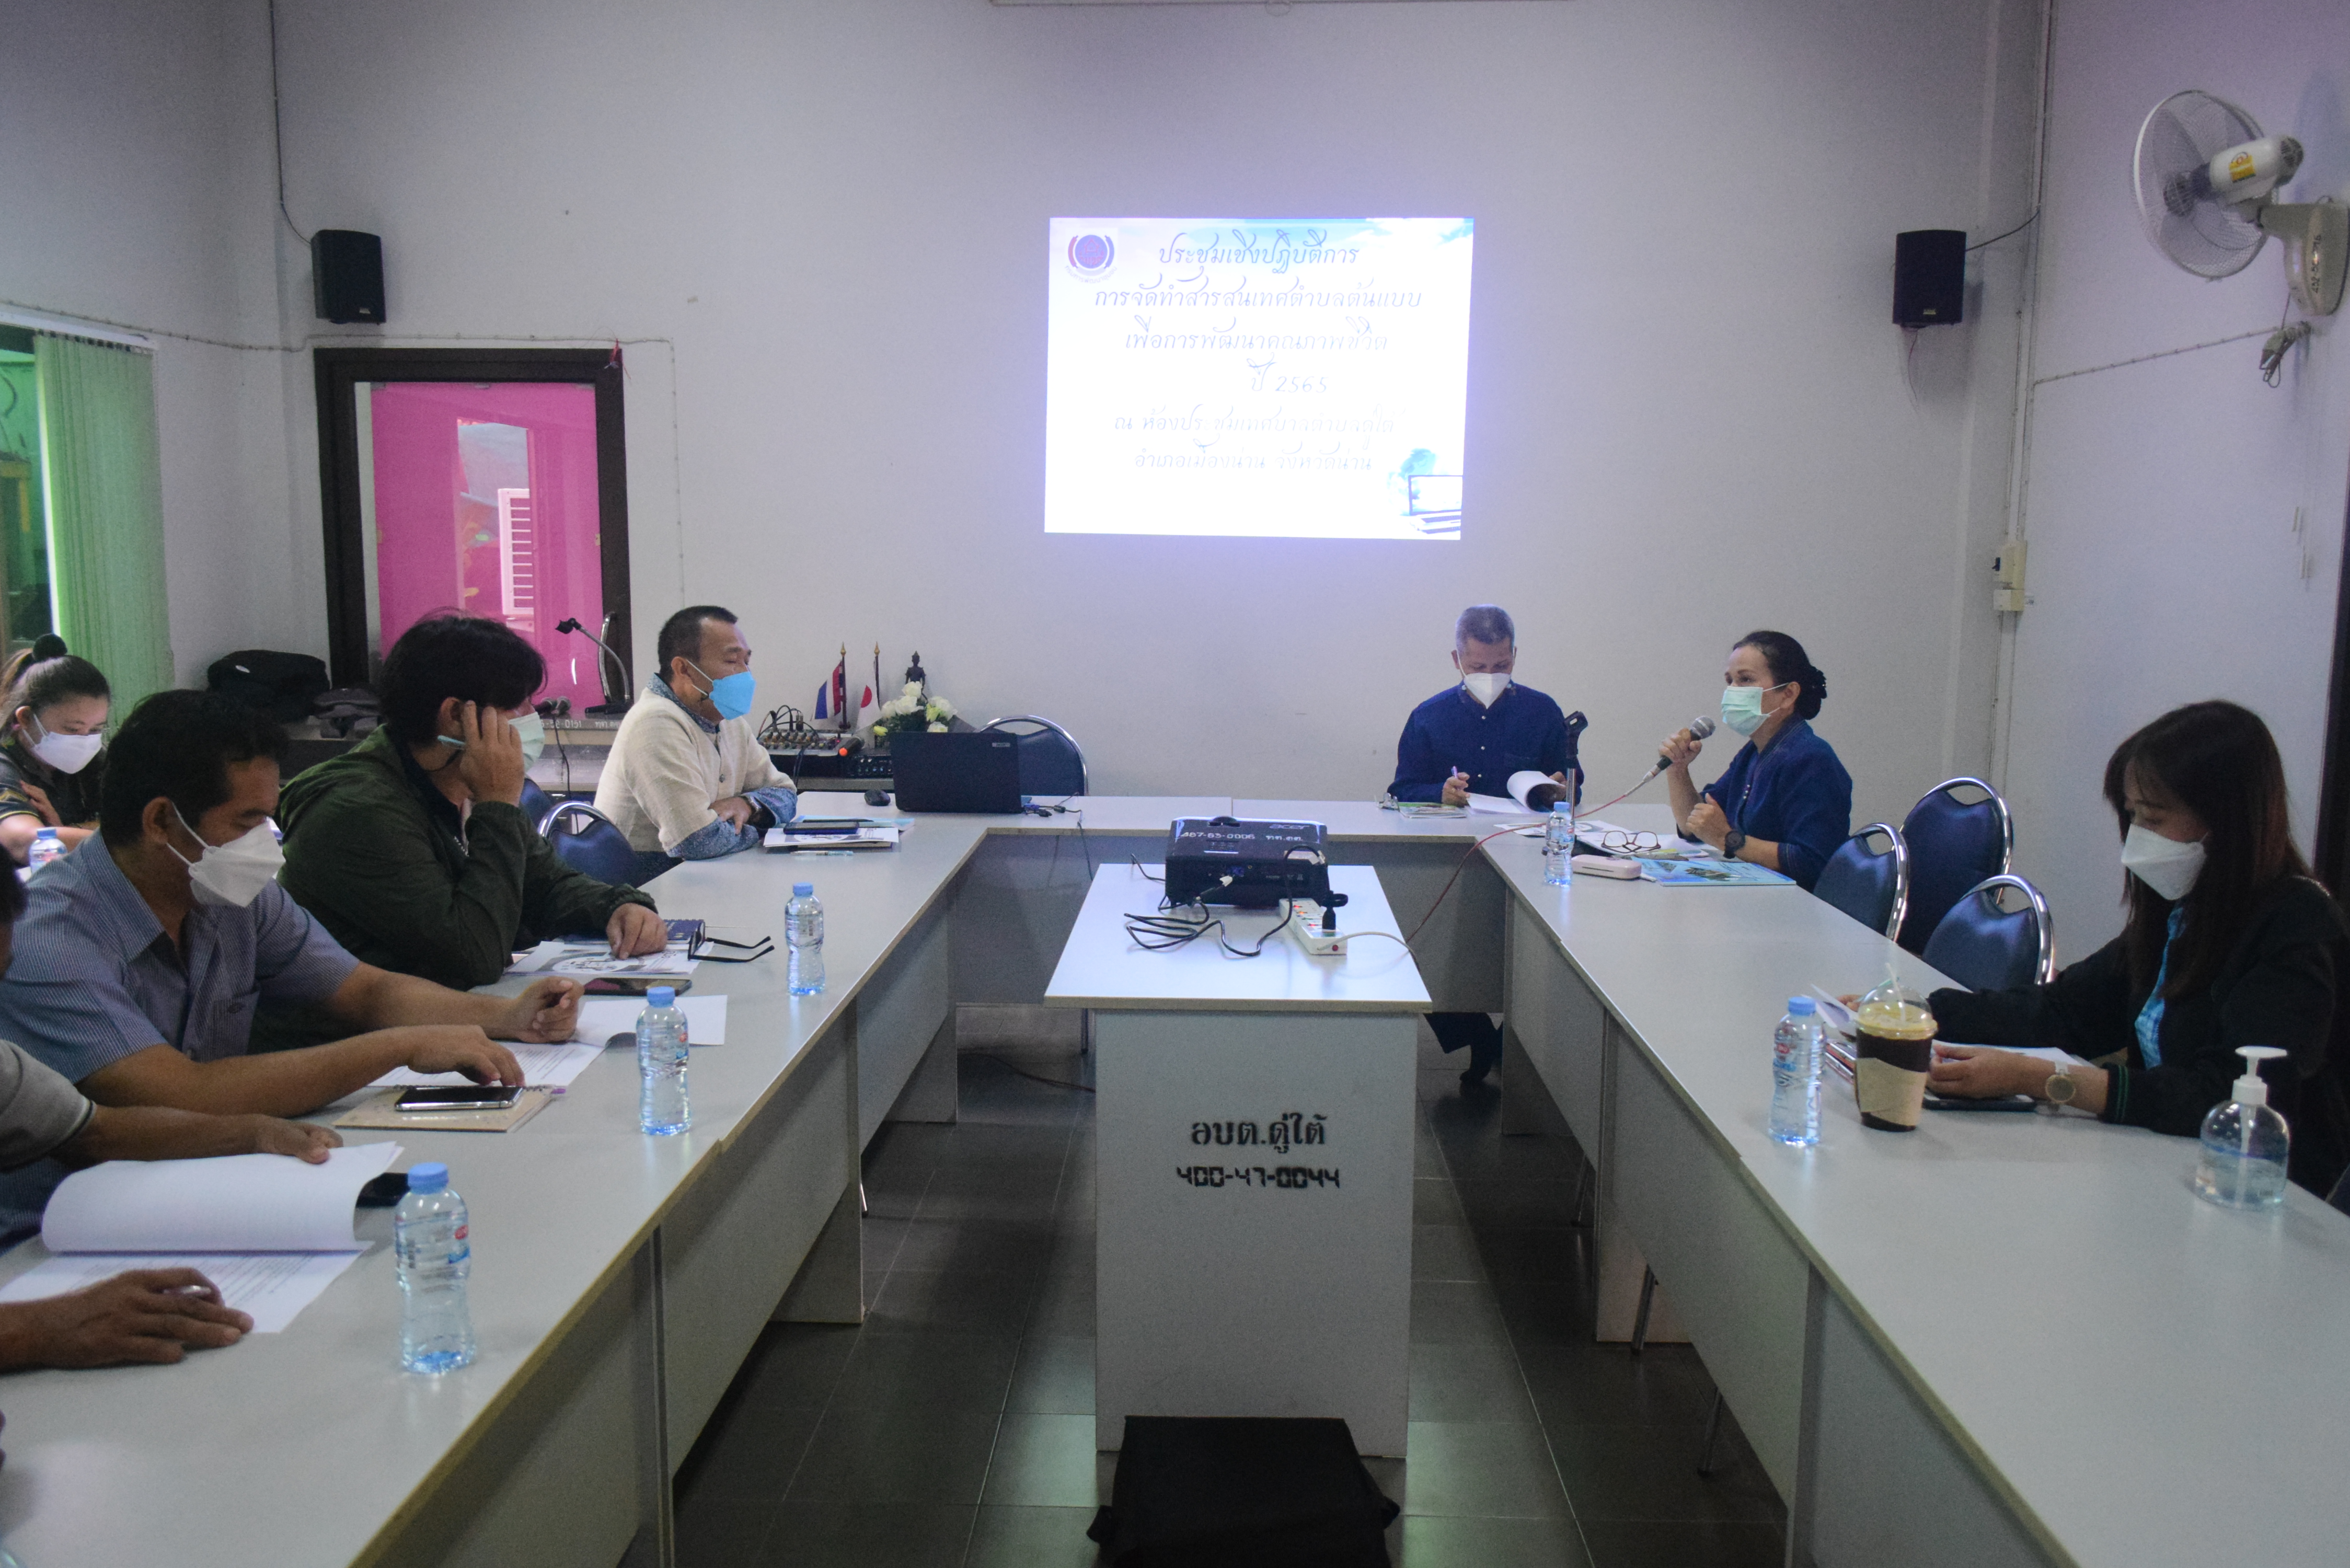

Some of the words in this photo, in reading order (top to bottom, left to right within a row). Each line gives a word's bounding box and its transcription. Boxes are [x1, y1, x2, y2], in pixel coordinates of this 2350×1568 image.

[1159, 229, 1360, 283] ประชุมเชิงปฏิบัติการ
[1095, 272, 1422, 308] การจัดทำสารสนเทศตำบลต้นแบบ
[1125, 314, 1389, 365] เพื่อการพัฒนาคุณภาพชีวิต
[1246, 357, 1277, 392] ปี
[1274, 375, 1329, 394] 2565
[1114, 417, 1133, 431] ณ
[1134, 438, 1266, 469] อำเภอเมืองน่าน
[1274, 441, 1372, 471] จังหวัดน่าน
[1180, 832, 1255, 840] 487-63-0006
[1191, 1112, 1328, 1154] อบต.ดู่ใต้
[1176, 1166, 1341, 1189] 400-47-0044
